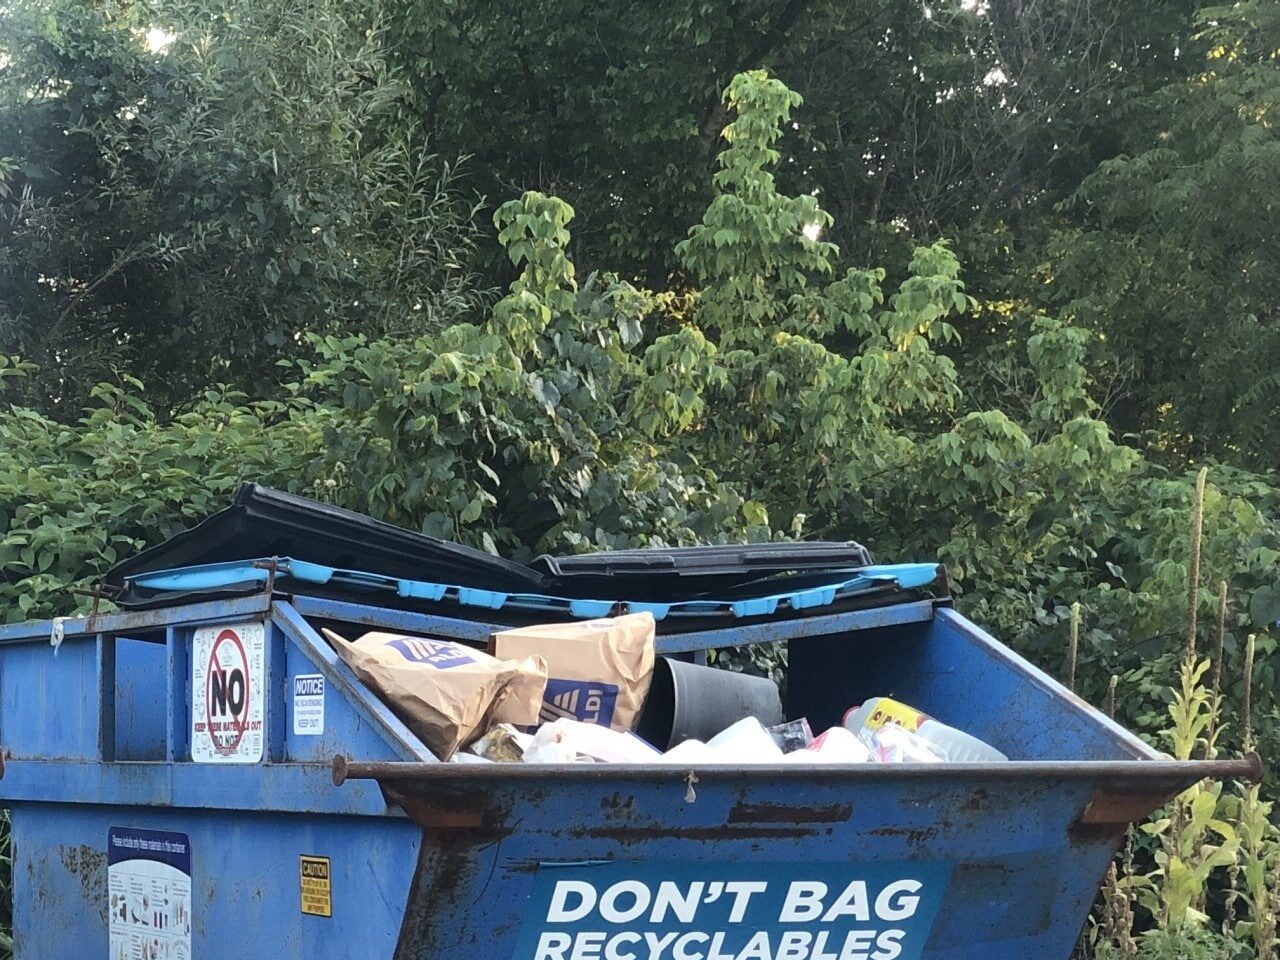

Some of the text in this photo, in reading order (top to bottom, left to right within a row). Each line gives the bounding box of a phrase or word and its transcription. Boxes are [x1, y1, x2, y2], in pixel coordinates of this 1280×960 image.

[210, 667, 245, 717] NO
[295, 678, 323, 695] NOTICE
[545, 879, 924, 924] DON'T BAG
